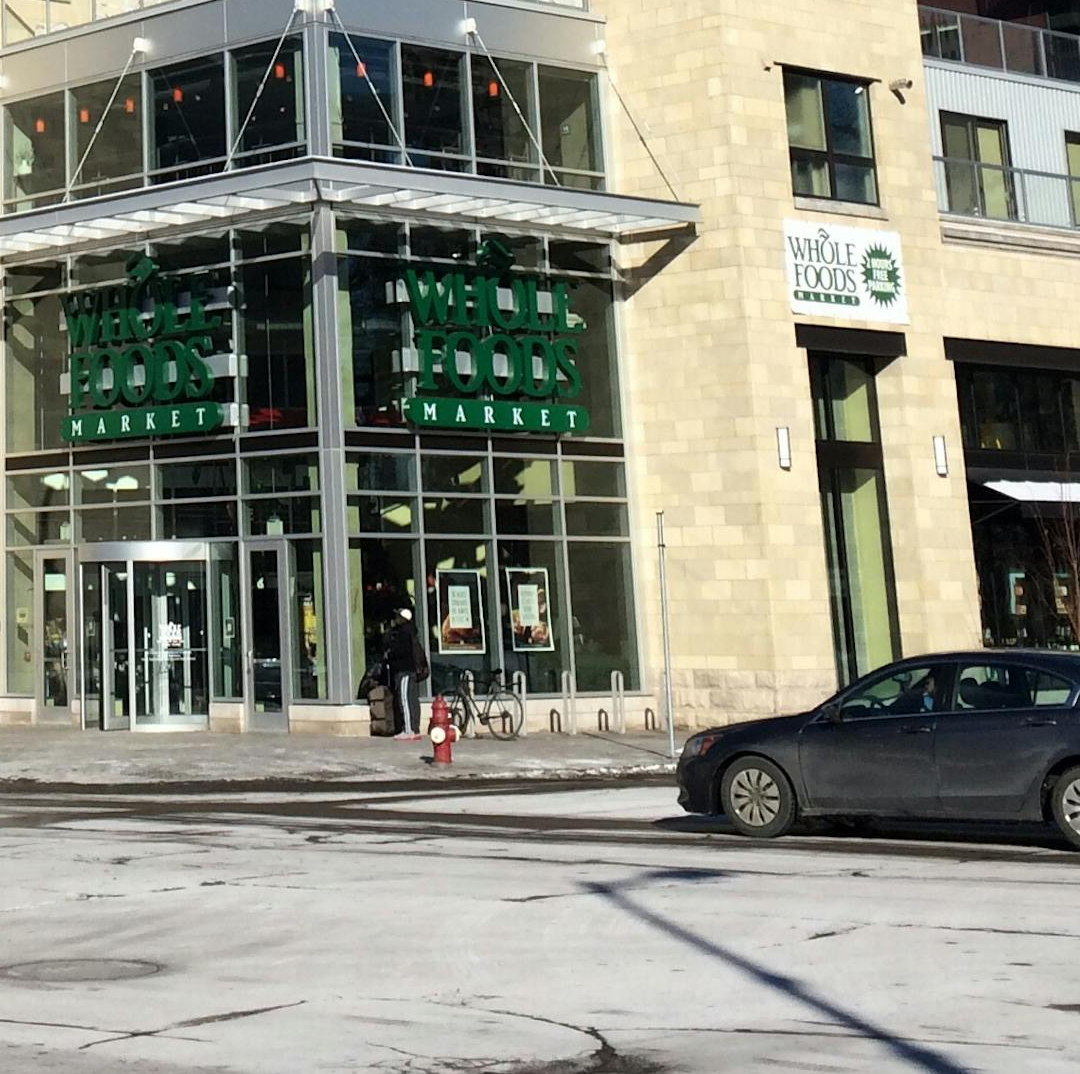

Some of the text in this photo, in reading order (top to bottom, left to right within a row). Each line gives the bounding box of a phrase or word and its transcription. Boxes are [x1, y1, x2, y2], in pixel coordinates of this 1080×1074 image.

[787, 235, 858, 267] WHOLE
[793, 262, 857, 293] FOODS
[59, 275, 222, 350] WHOLE
[406, 268, 586, 334] WHOLE
[797, 291, 858, 306] MARKET
[70, 336, 215, 409] FOODS
[417, 330, 584, 398] FOODS
[71, 407, 206, 437] MARKET
[423, 402, 577, 428] MARKET
